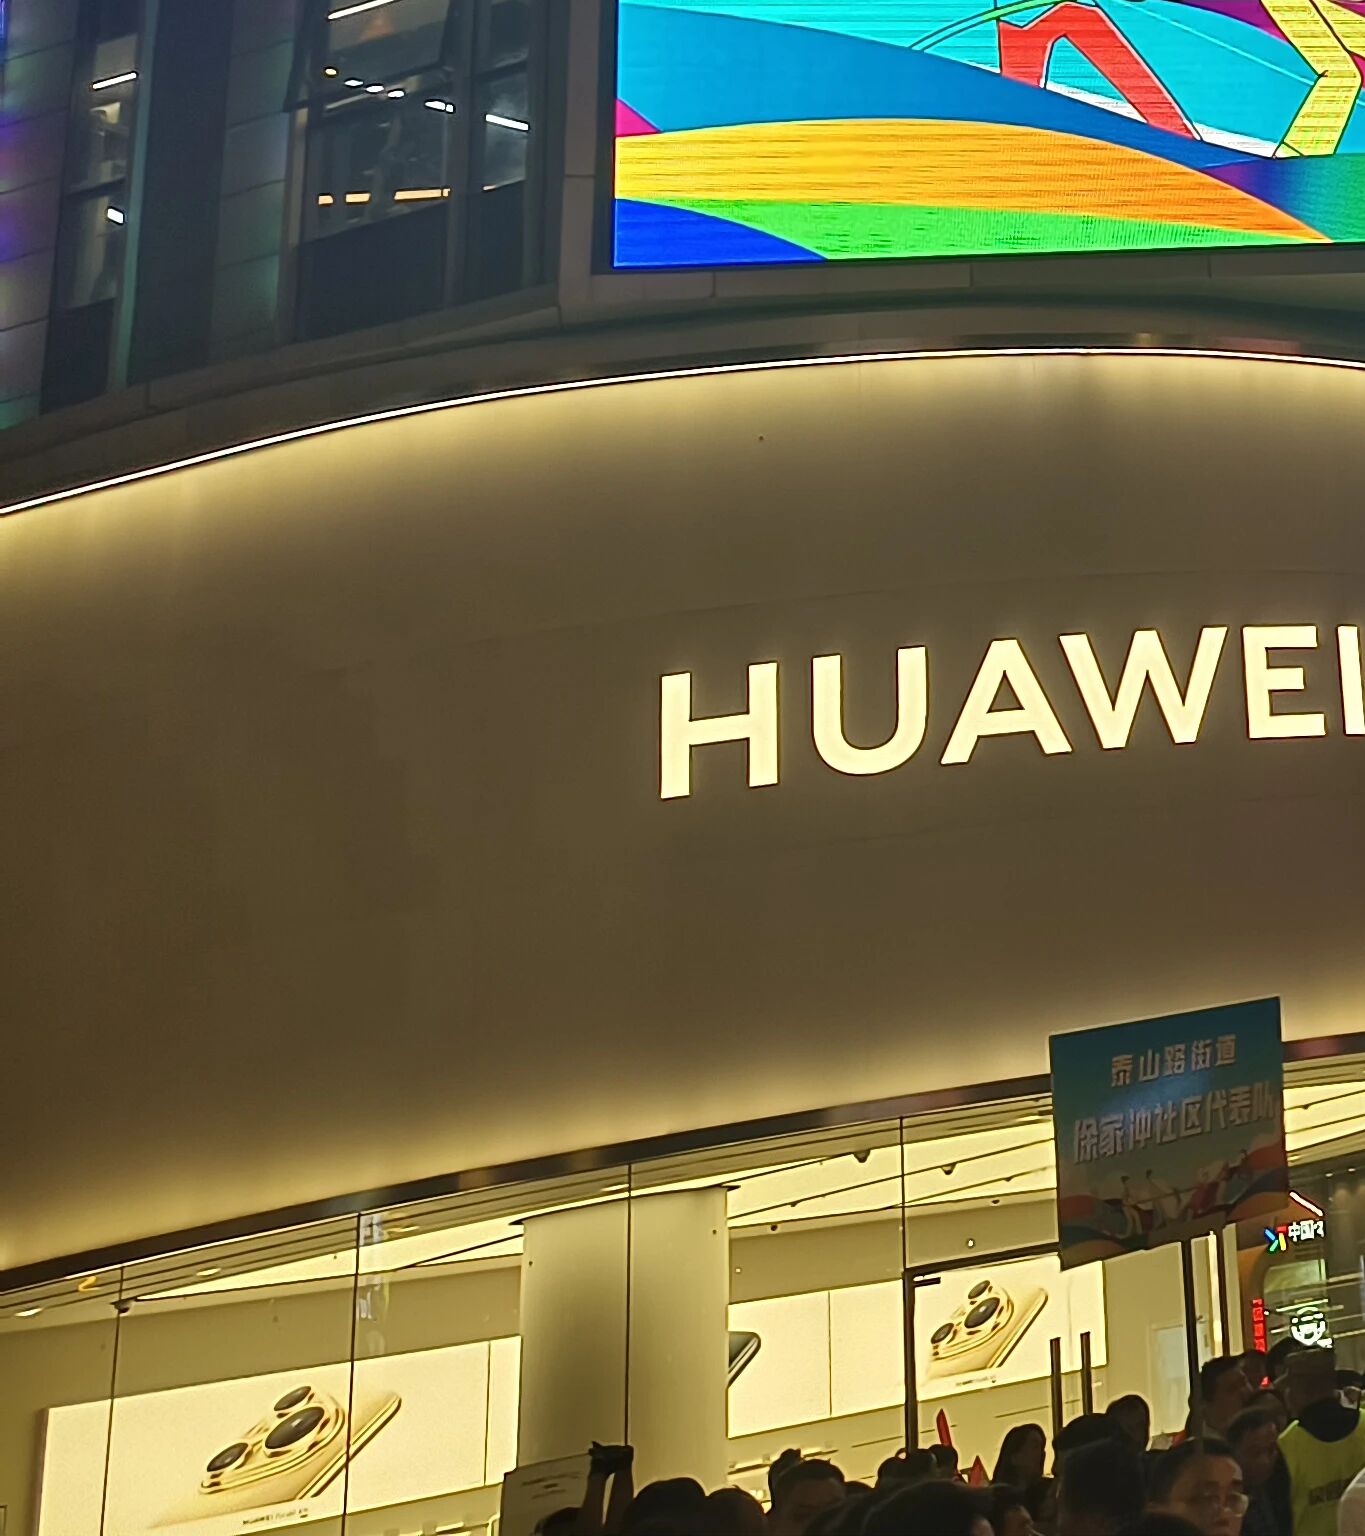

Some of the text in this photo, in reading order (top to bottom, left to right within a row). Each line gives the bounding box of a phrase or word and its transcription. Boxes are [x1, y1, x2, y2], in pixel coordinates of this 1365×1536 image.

[1110, 1034, 1237, 1088] 泰山路街道
